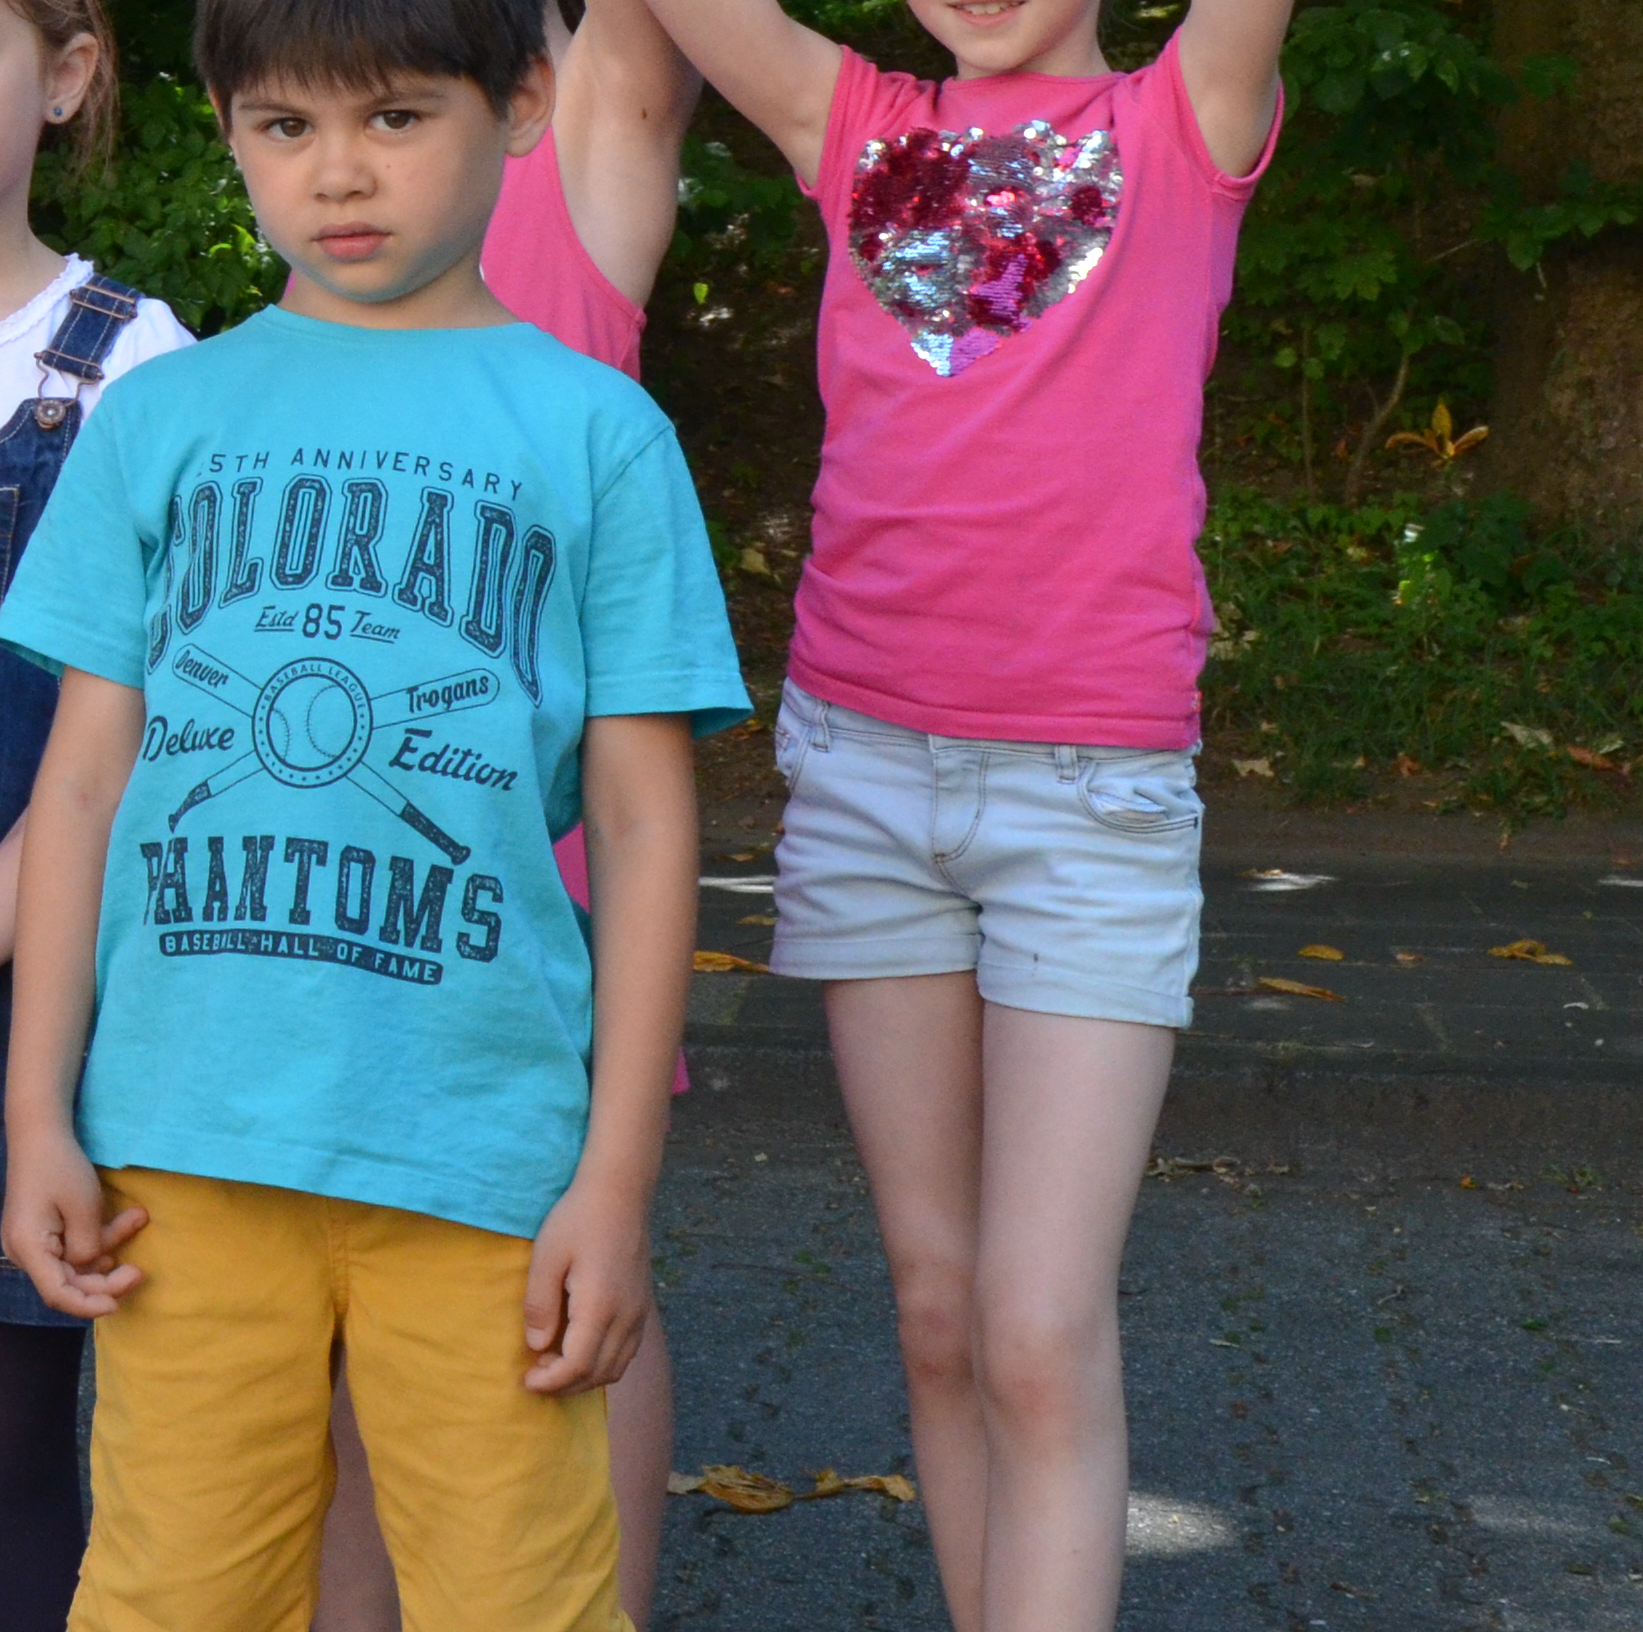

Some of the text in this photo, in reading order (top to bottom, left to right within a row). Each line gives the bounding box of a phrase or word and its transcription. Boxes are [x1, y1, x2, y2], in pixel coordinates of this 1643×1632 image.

[290, 447, 524, 501] ANNIVERSARY
[302, 603, 346, 640] 85
[350, 610, 401, 641] Team
[175, 649, 229, 689] Denver
[264, 663, 367, 709] BASEBALL LEAGUE
[406, 676, 489, 714] Trogans
[142, 715, 518, 791] Deluxe Edition
[140, 835, 504, 963] PHANTOMS
[260, 934, 319, 957] HALL
[336, 942, 363, 964] OF
[374, 951, 437, 982] FAME
